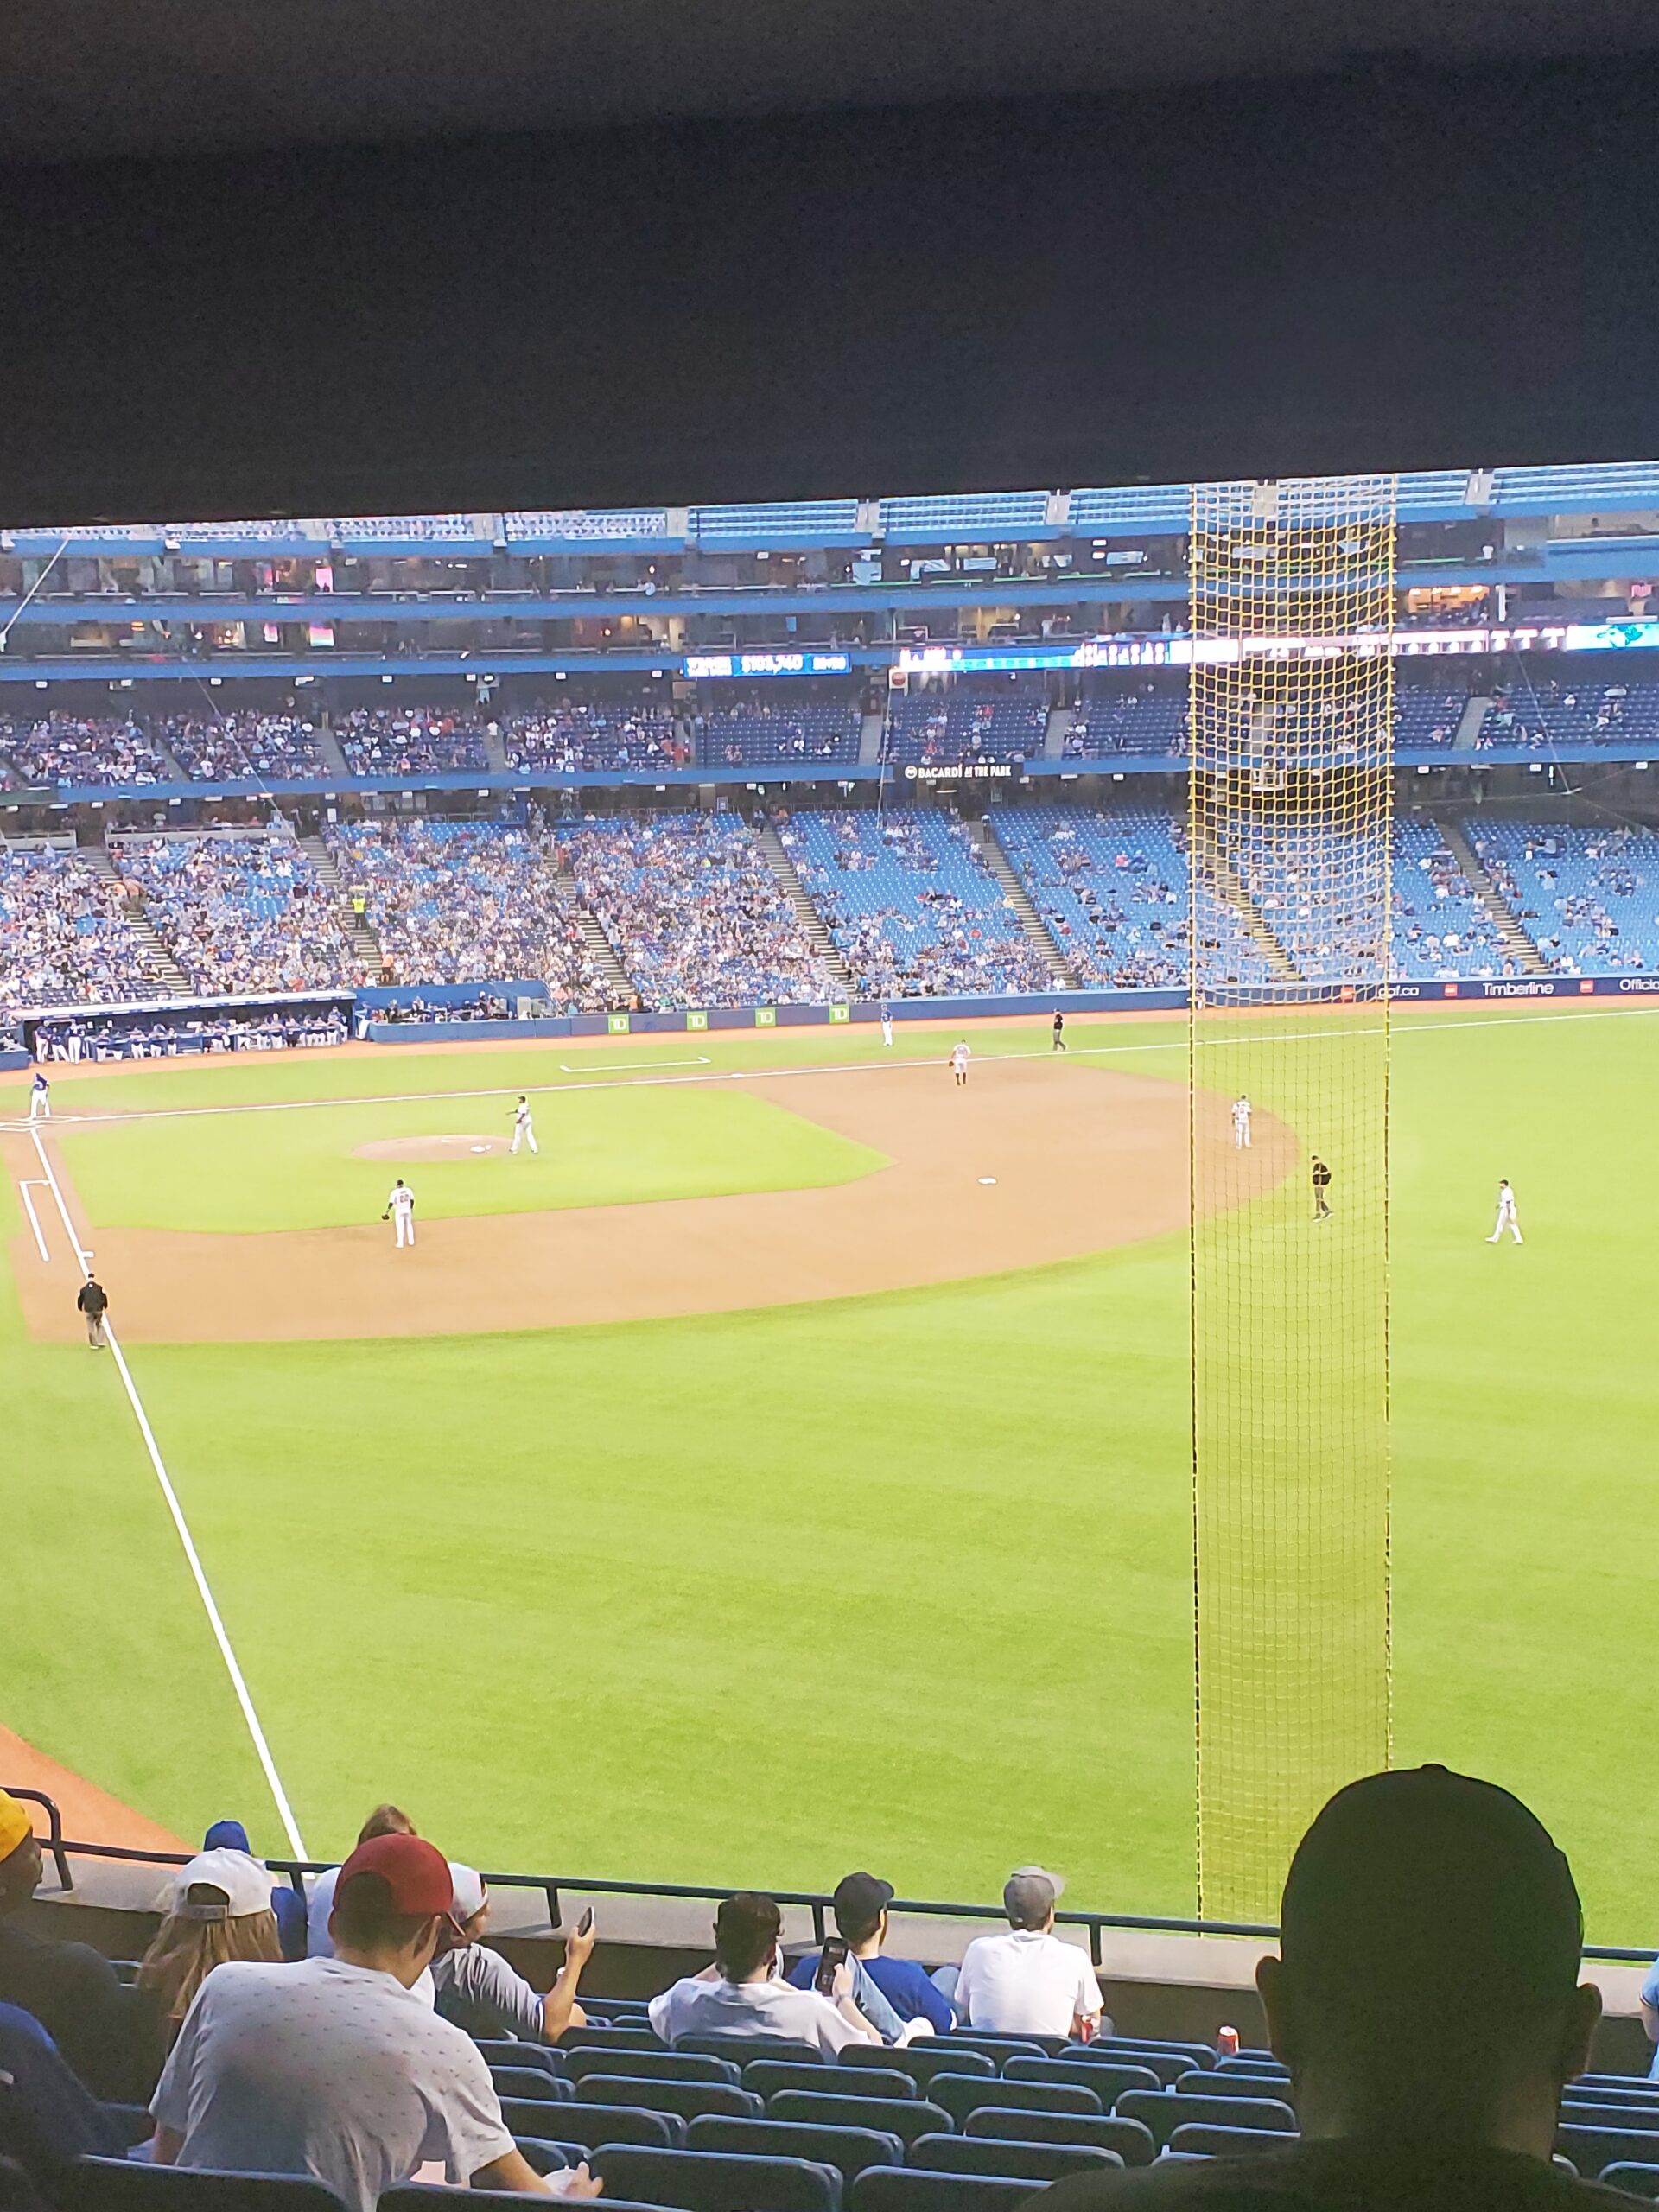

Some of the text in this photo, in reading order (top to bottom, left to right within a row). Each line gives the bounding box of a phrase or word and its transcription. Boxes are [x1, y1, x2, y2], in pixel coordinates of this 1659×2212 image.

[990, 766, 1012, 777] PARK
[1482, 981, 1554, 996] Timberline
[758, 1011, 774, 1024] TD
[832, 1007, 848, 1020] TD
[609, 1018, 627, 1031] TD
[689, 1014, 705, 1027] TD
